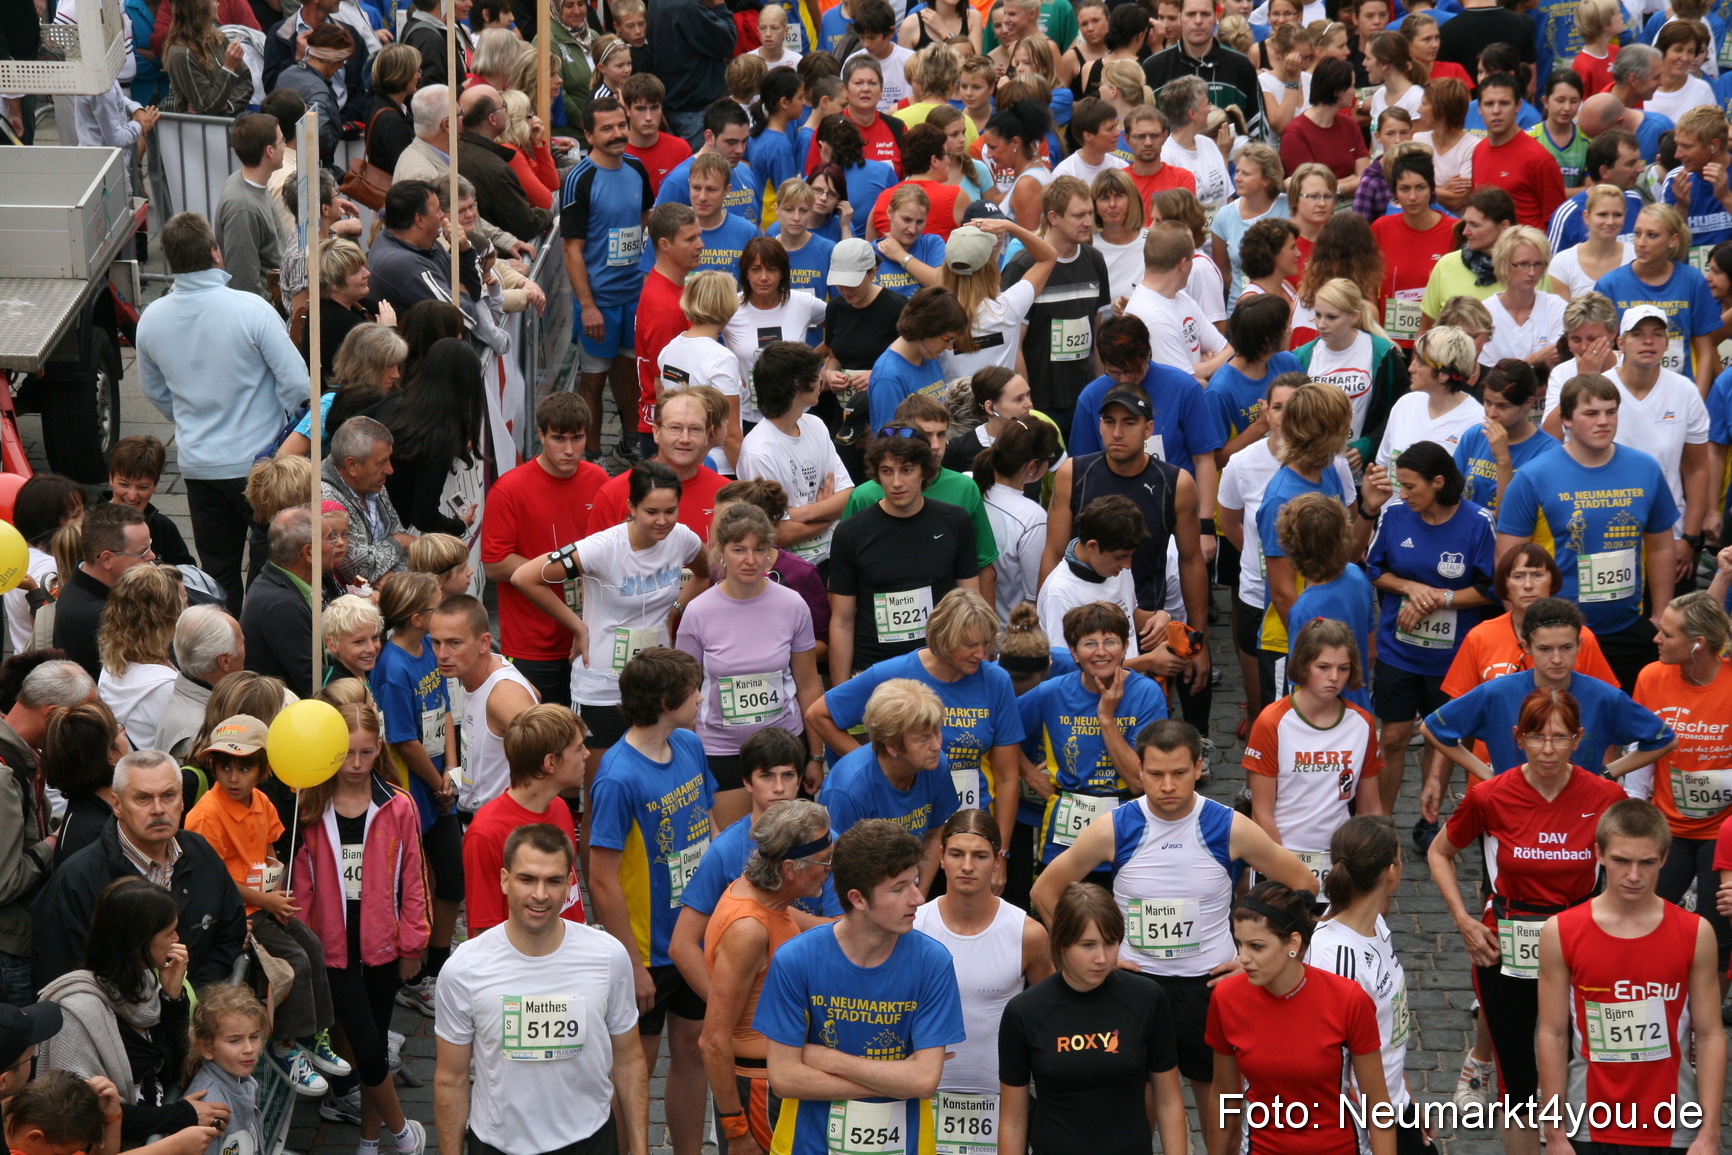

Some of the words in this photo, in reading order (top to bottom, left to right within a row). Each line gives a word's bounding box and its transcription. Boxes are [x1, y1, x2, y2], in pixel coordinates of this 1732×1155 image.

[786, 33, 798, 43] 62
[1561, 167, 1579, 176] CK
[621, 239, 640, 254] 3652
[1066, 332, 1090, 347] 5227
[1661, 356, 1679, 368] 65
[1558, 492, 1573, 502] 10.
[1575, 488, 1644, 501] NEUMARKTER
[1574, 497, 1633, 509] STADTLAUF
[1441, 562, 1461, 571] STAUF
[1447, 555, 1458, 564] SV
[1597, 567, 1631, 585] 5250
[889, 596, 915, 608] Martin
[892, 606, 929, 626] 5221
[736, 679, 763, 690] Karina
[739, 690, 779, 709] 5064
[1059, 715, 1073, 725] 10.
[1664, 717, 1730, 735] Fischer
[1295, 751, 1353, 766] MERZ
[1291, 760, 1341, 773] Reisen
[1685, 774, 1710, 787] Birgit
[646, 800, 661, 813] 10.
[1075, 798, 1097, 814] Maria
[1538, 832, 1568, 844] DAV
[683, 846, 702, 864] Daniel
[1513, 846, 1592, 861] Röthenbach
[1145, 904, 1176, 917] Martin
[1148, 920, 1194, 940] 5147
[1614, 979, 1681, 1002] EnBW
[526, 1000, 568, 1014] Matthes
[812, 995, 828, 1008] 10.
[830, 996, 918, 1013] NEUMARKTER
[827, 1008, 902, 1025] STADTLAUF
[1604, 1008, 1634, 1024] Björn
[527, 1019, 579, 1039] 5129
[1610, 1022, 1662, 1043] 5172
[1057, 1032, 1112, 1053] ROXY
[943, 1097, 995, 1111] Konstantin
[943, 1116, 993, 1136] 5186
[850, 1126, 900, 1146] 5254
